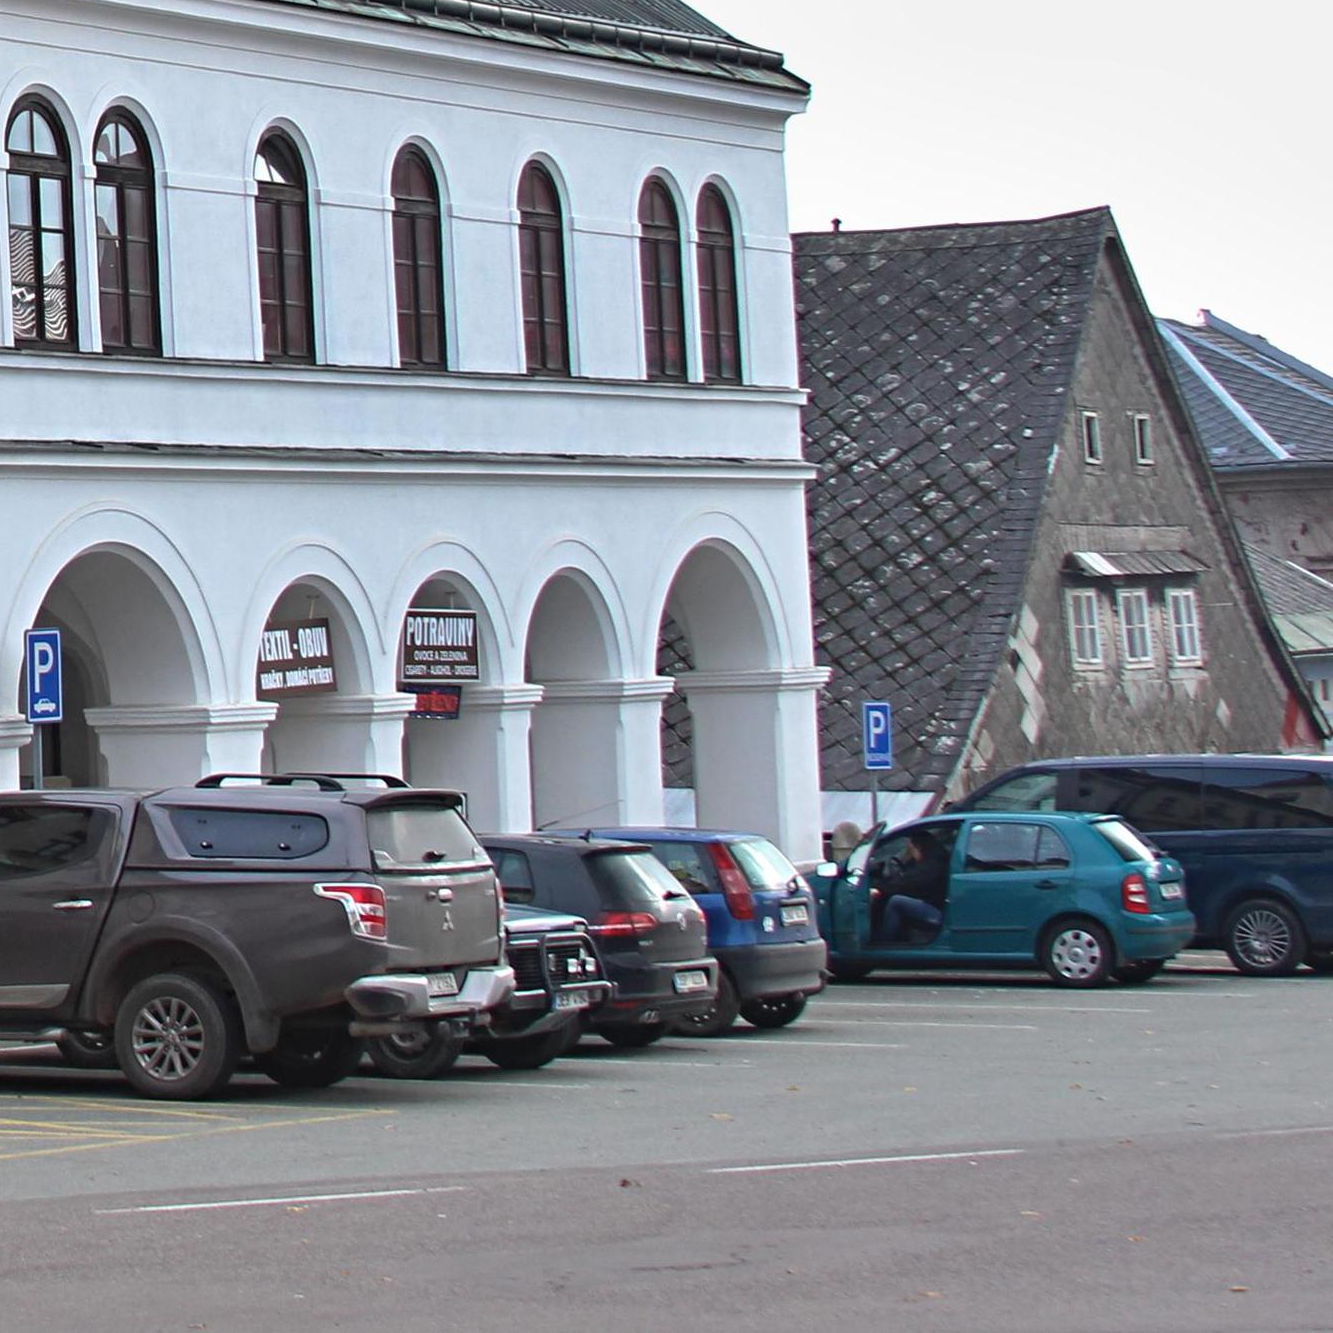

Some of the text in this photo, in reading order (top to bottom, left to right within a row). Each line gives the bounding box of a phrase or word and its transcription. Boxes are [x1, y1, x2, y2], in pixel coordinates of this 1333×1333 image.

[298, 627, 329, 659] OBUV
[406, 616, 473, 647] POTRAVINY
[34, 641, 54, 693] P
[869, 710, 886, 748] P
